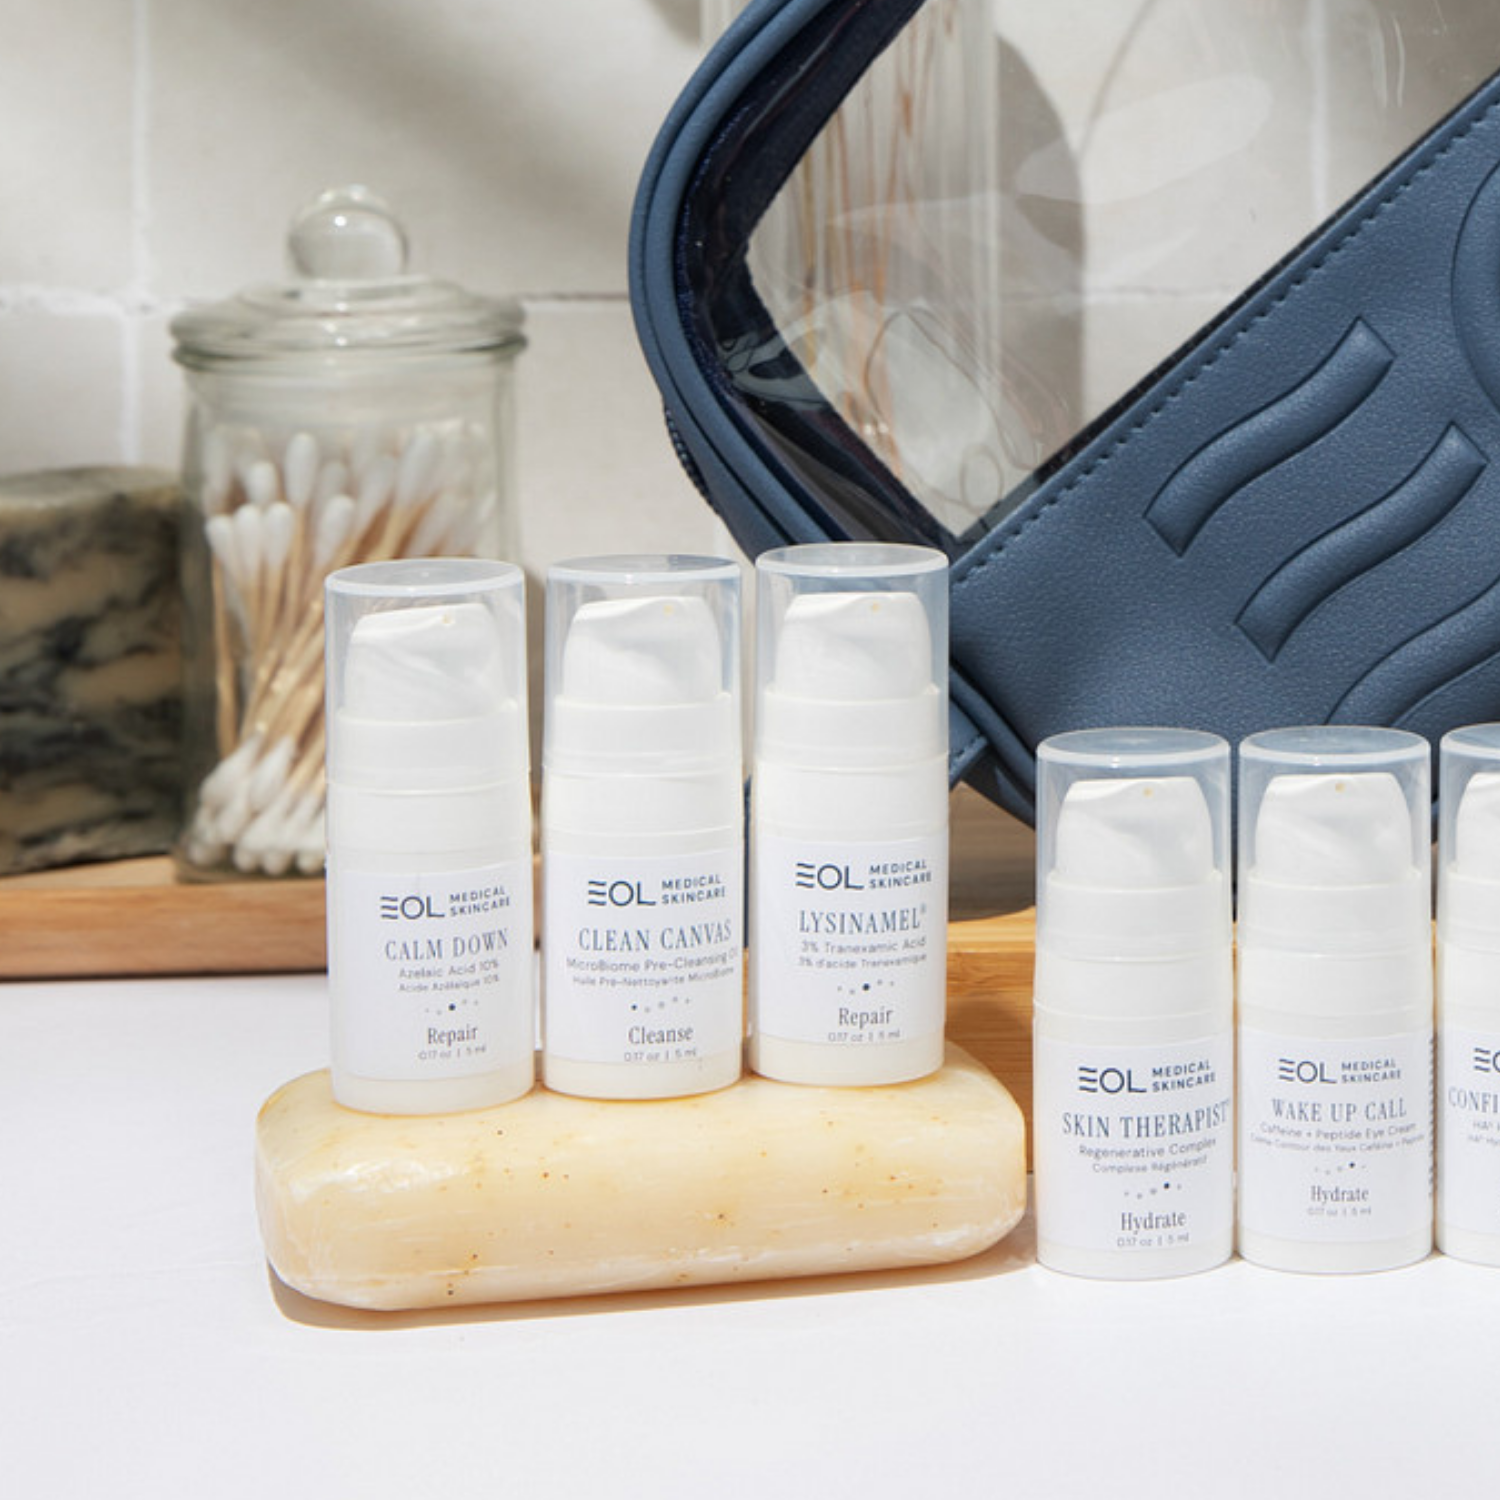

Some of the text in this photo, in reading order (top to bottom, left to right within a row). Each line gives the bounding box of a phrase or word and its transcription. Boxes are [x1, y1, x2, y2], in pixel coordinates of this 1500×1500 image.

[795, 862, 865, 890] EOL
[869, 859, 927, 875] MEDICAL
[661, 874, 721, 890] MEDICAL
[869, 871, 932, 889] SKINCARE
[450, 885, 505, 903] MEDICAL
[588, 880, 657, 907] EOL
[380, 896, 446, 920] EOL
[385, 928, 508, 961] CALM DOWN
[579, 918, 732, 951] CLEAN CANVAS
[902, 936, 926, 950] Acid
[448, 963, 476, 975] Acid
[838, 1006, 894, 1030] Repair
[428, 1023, 478, 1047] Repair
[628, 1026, 693, 1044] Cleanse
[1152, 1059, 1211, 1078] MEDICAL
[1278, 1058, 1337, 1084] EOL
[1341, 1057, 1396, 1072] MEDICAL
[1078, 1067, 1147, 1094] EOL
[1152, 1072, 1216, 1093] SKINCARE
[1272, 1096, 1407, 1122] WAKE UP CALL
[1063, 1112, 1110, 1139] SKIN
[1316, 1129, 1362, 1141] Peptide
[1366, 1127, 1385, 1140] Eye
[1079, 1144, 1165, 1159] Regenerative
[1311, 1185, 1369, 1206] Hydrate
[1121, 1211, 1187, 1235] Hydrate
